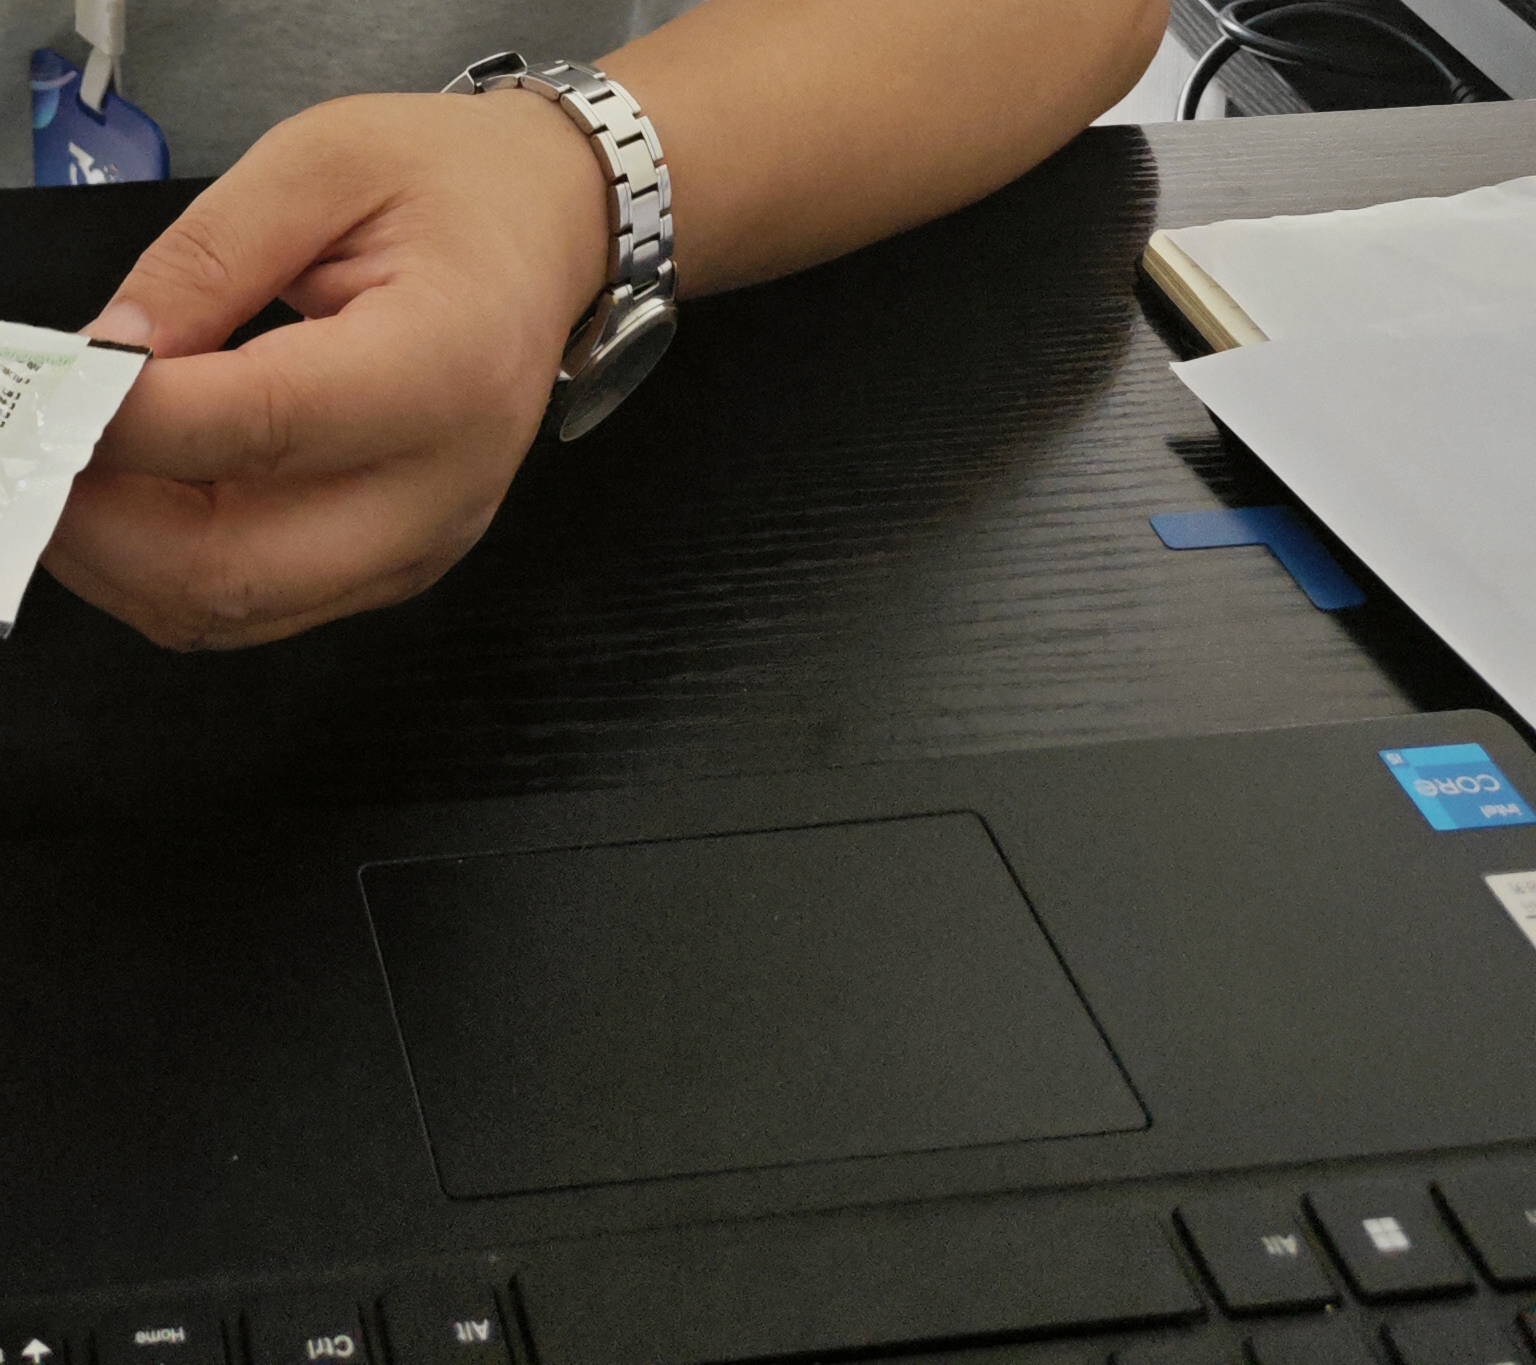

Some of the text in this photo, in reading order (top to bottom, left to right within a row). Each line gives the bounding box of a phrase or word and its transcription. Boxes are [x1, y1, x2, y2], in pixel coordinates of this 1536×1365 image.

[134, 1325, 186, 1346] Home
[454, 1319, 491, 1344] Alt
[306, 1332, 356, 1361] Ctrl
